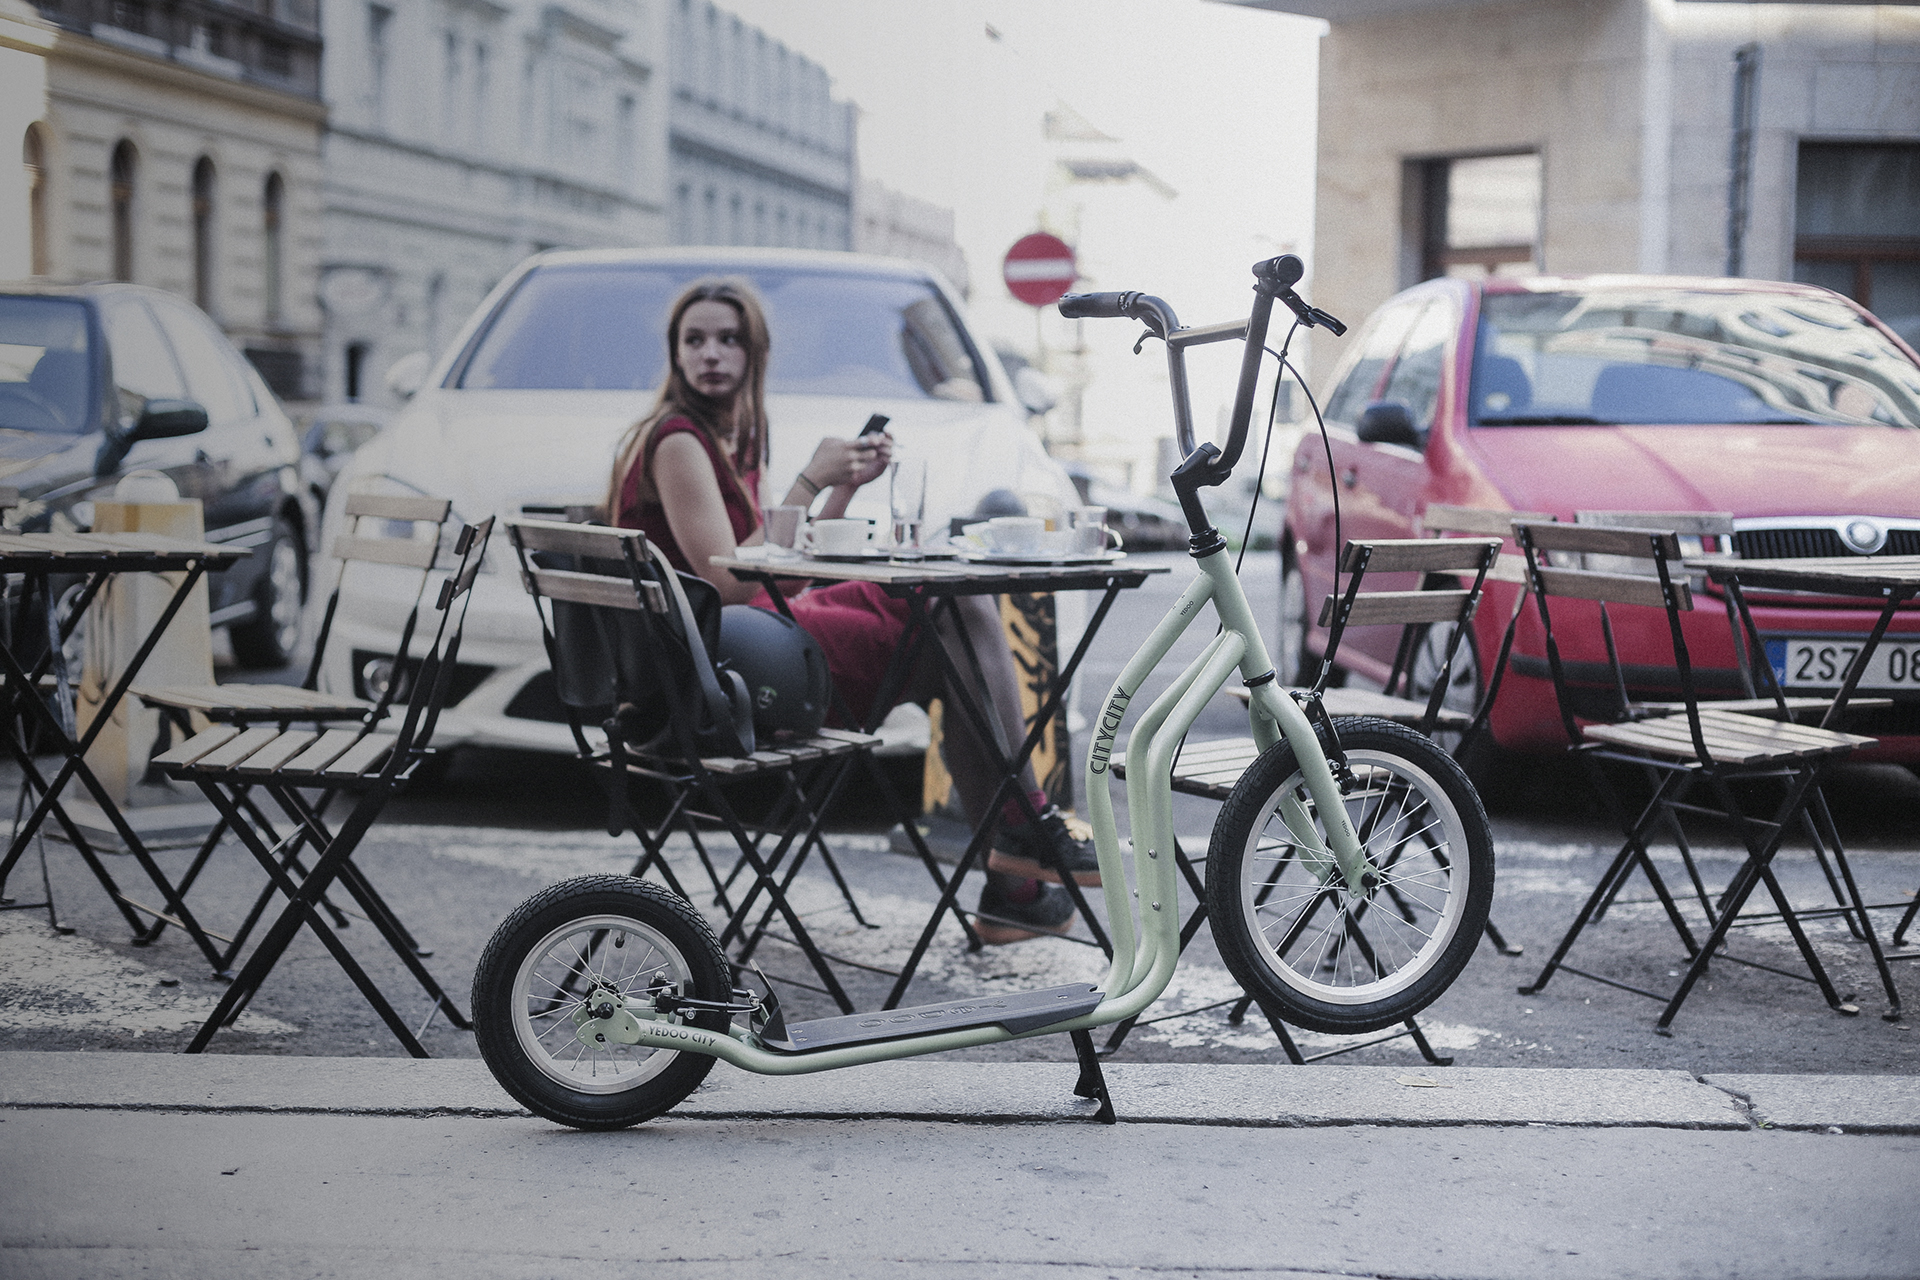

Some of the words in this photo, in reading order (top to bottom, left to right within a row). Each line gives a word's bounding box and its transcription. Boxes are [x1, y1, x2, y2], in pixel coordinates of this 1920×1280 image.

[1090, 685, 1131, 775] CITYCITY
[649, 1026, 689, 1040] YEDOO
[692, 1033, 717, 1047] CITY
